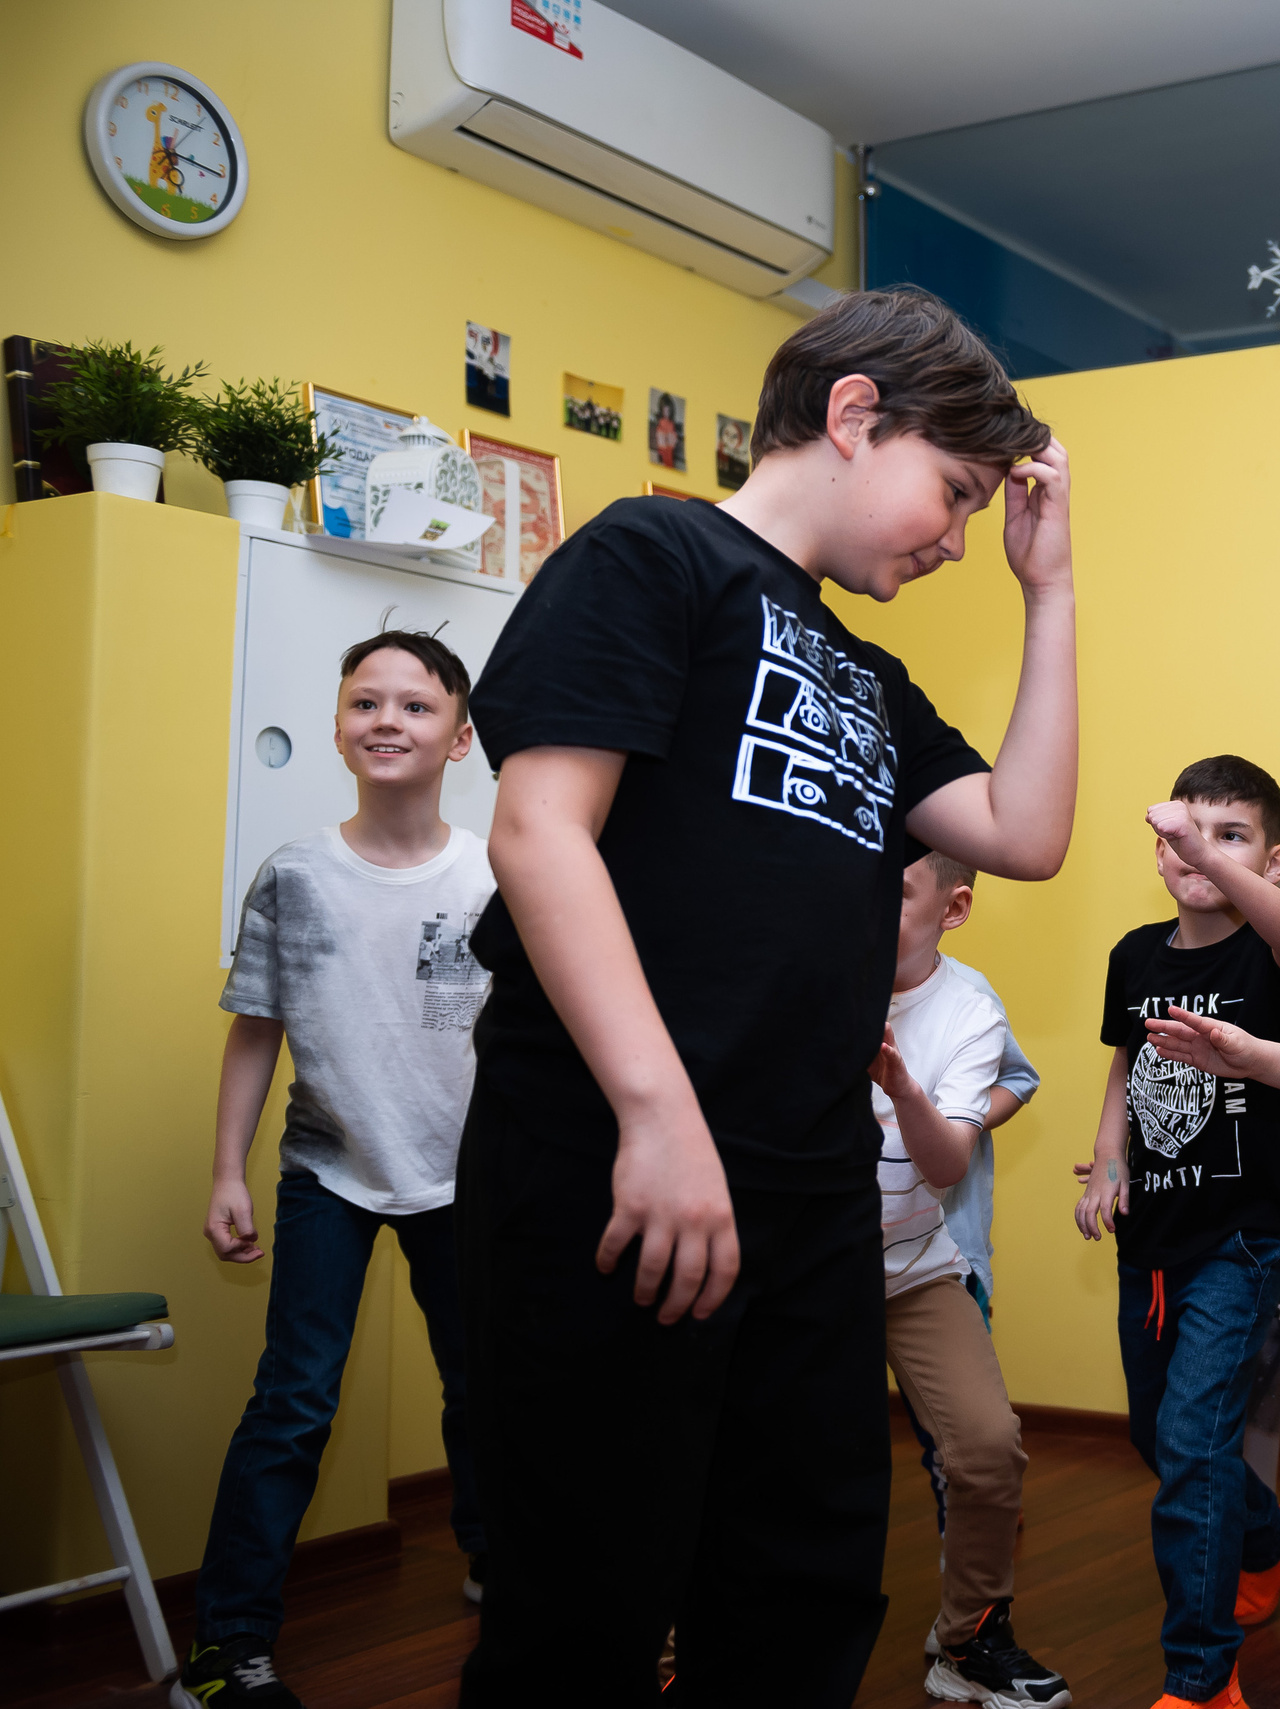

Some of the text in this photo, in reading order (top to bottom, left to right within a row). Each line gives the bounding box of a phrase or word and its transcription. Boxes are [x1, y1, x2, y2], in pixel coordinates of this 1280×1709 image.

[163, 82, 180, 102] 12
[212, 132, 221, 147] 2
[217, 163, 226, 179] 3
[210, 193, 219, 205] 4
[190, 206, 199, 220] 5
[1139, 992, 1220, 1018] ATTACK
